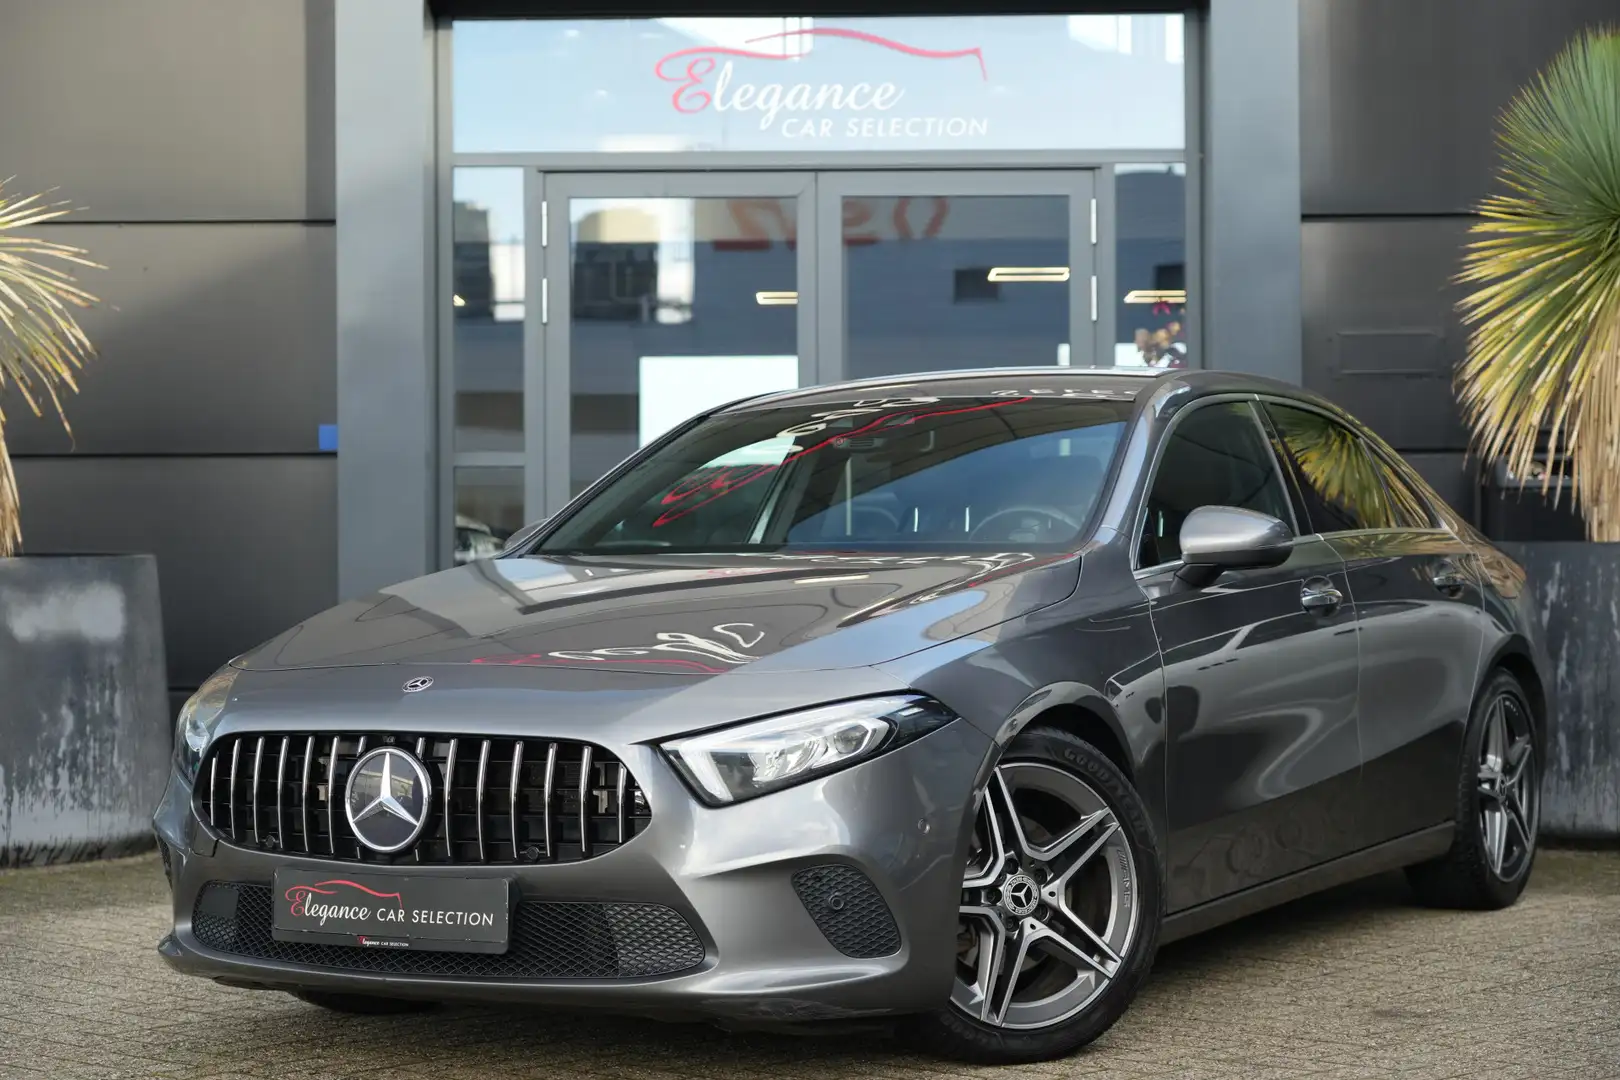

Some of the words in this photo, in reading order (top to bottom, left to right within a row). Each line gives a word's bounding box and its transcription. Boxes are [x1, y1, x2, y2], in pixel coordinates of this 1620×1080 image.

[655, 47, 906, 130] Elegance
[781, 118, 834, 138] CAR
[846, 117, 988, 137] SELECTION
[285, 886, 372, 926] Elegance
[376, 908, 405, 922] CAR
[411, 910, 494, 926] SELECTION
